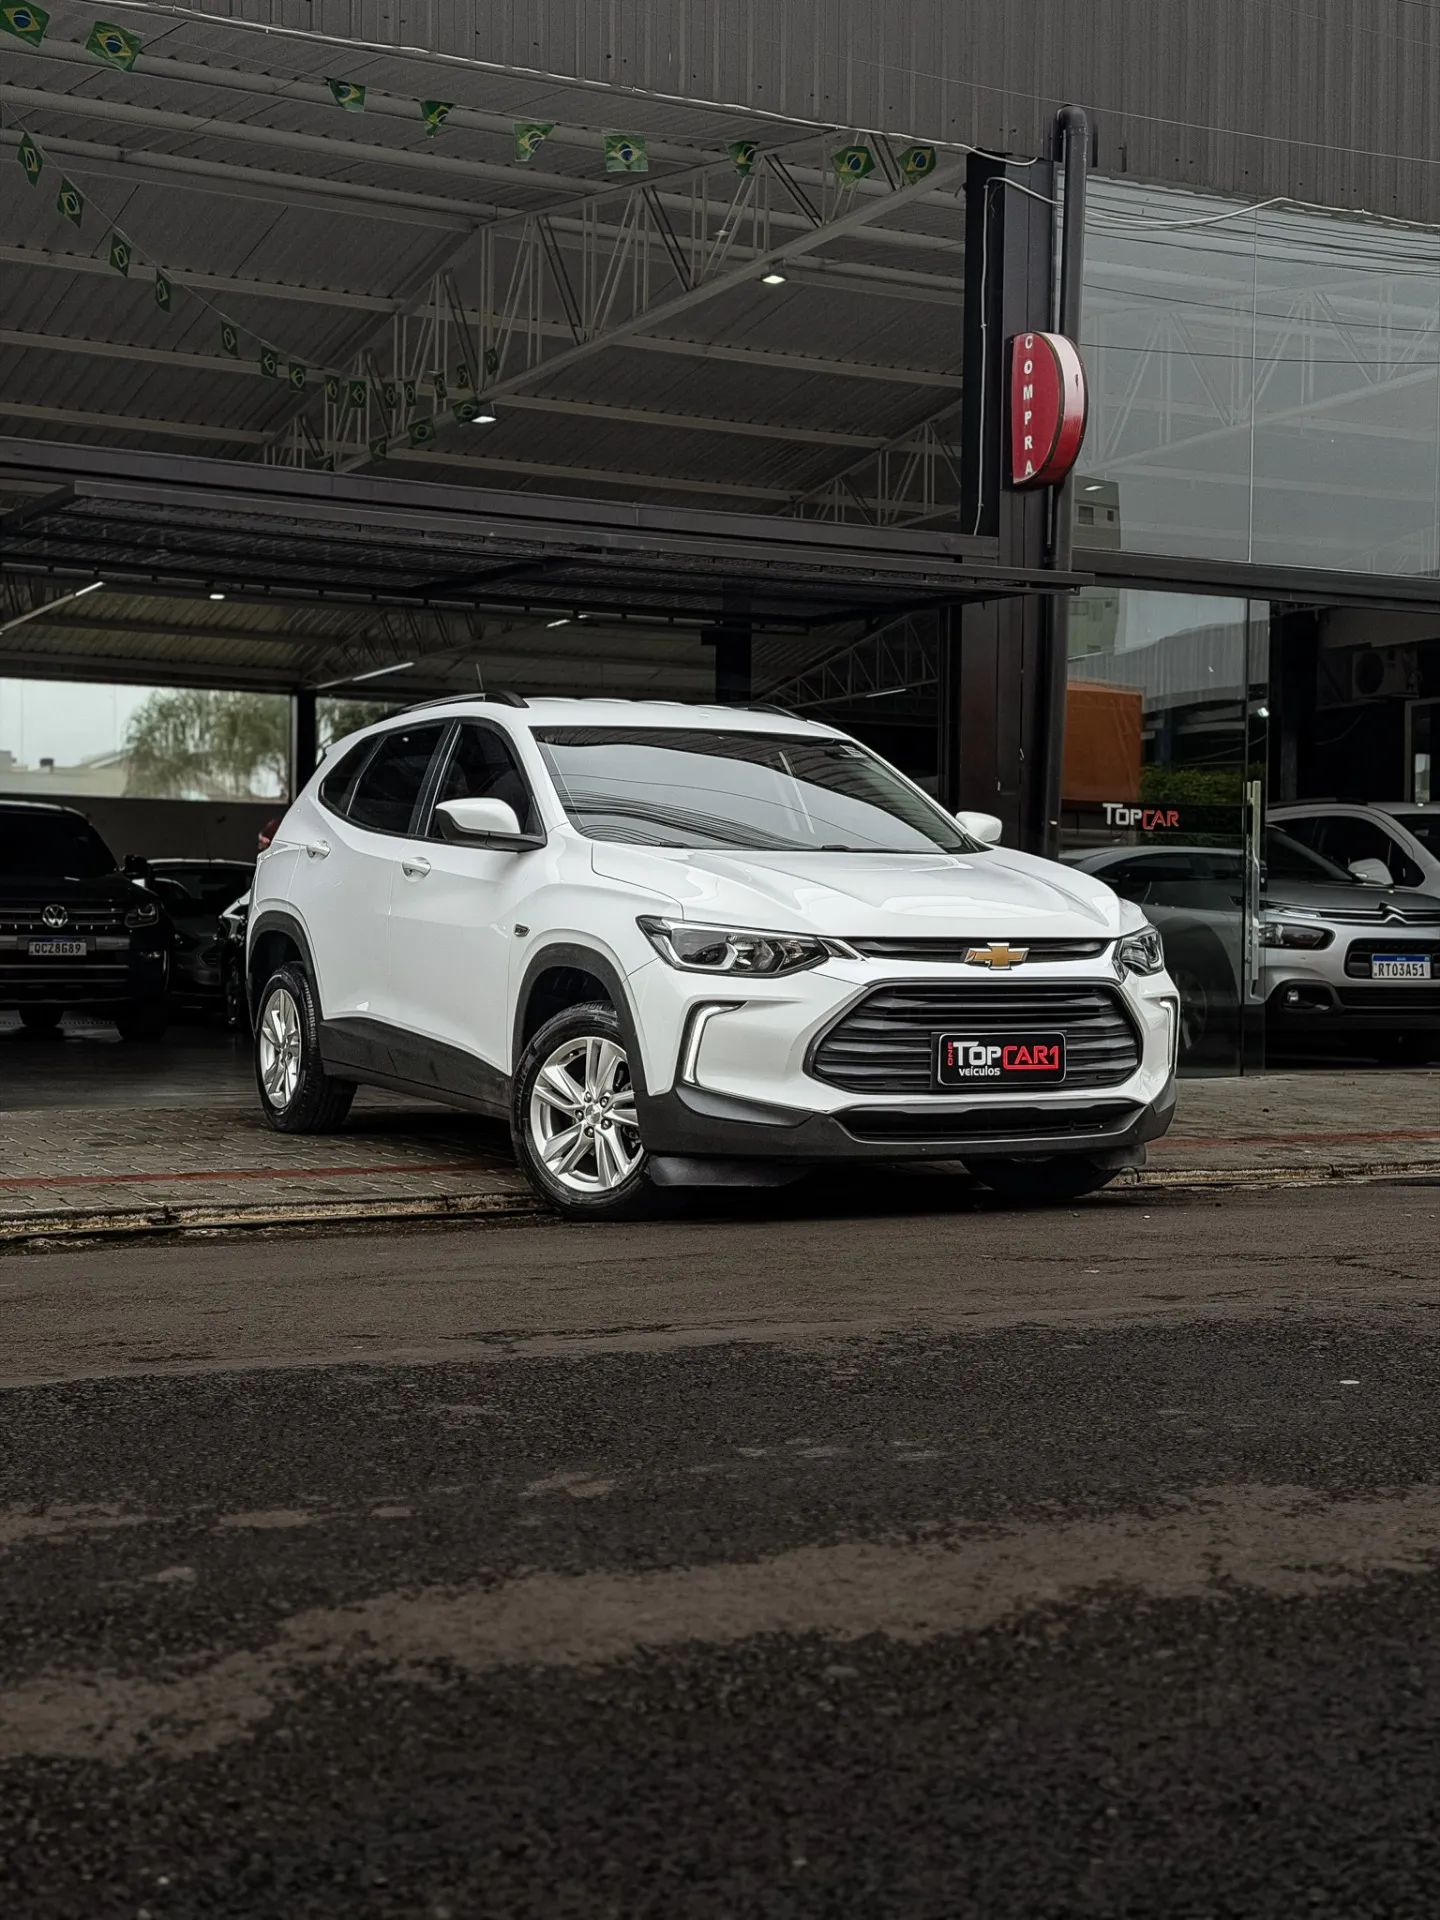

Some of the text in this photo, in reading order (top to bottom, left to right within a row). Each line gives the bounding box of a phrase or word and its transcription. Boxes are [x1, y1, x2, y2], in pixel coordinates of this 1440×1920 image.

[1023, 335, 1034, 476] COMPRA
[1101, 802, 1180, 830] TOPCAR
[958, 1065, 1001, 1077] veículos
